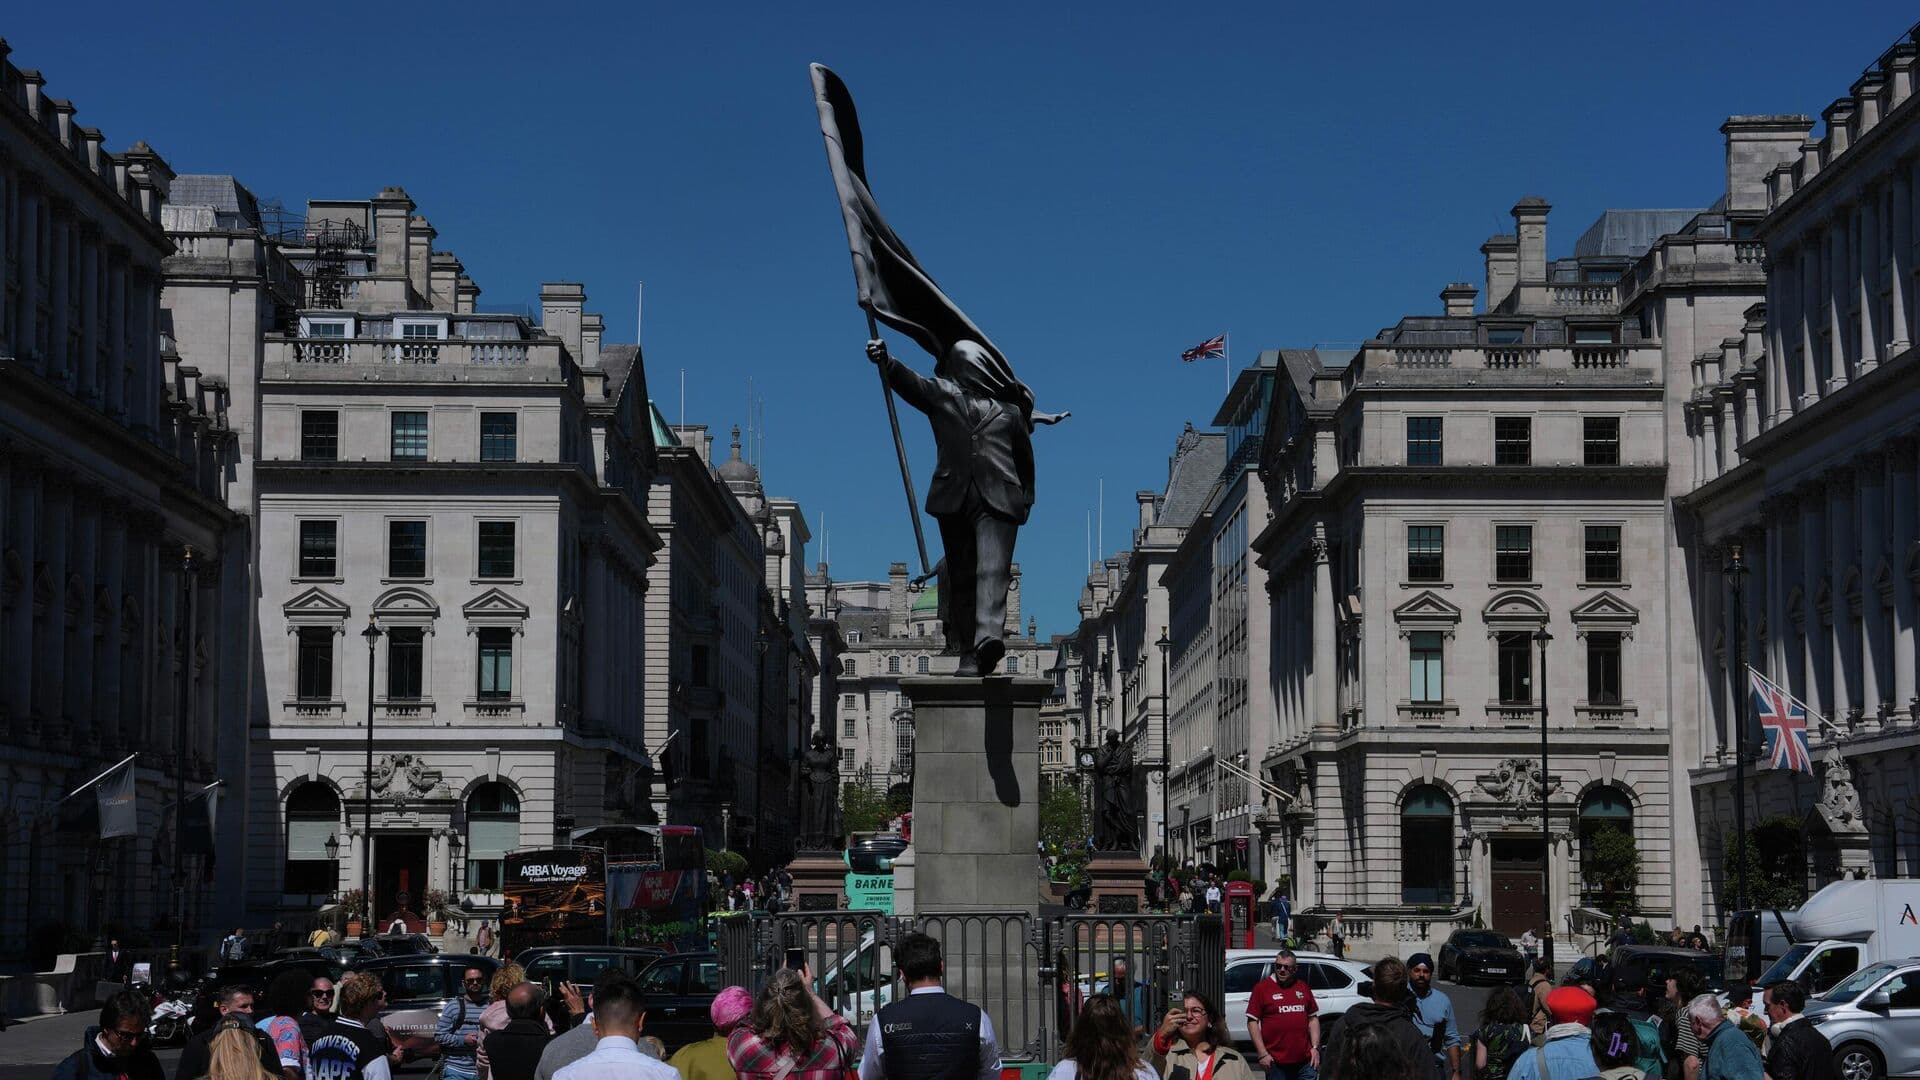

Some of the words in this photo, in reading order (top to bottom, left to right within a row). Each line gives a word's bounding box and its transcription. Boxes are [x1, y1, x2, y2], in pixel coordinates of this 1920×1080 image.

[520, 865, 549, 876] ABBA
[551, 865, 587, 877] Voyage
[312, 1035, 360, 1061] UNIVERSE
